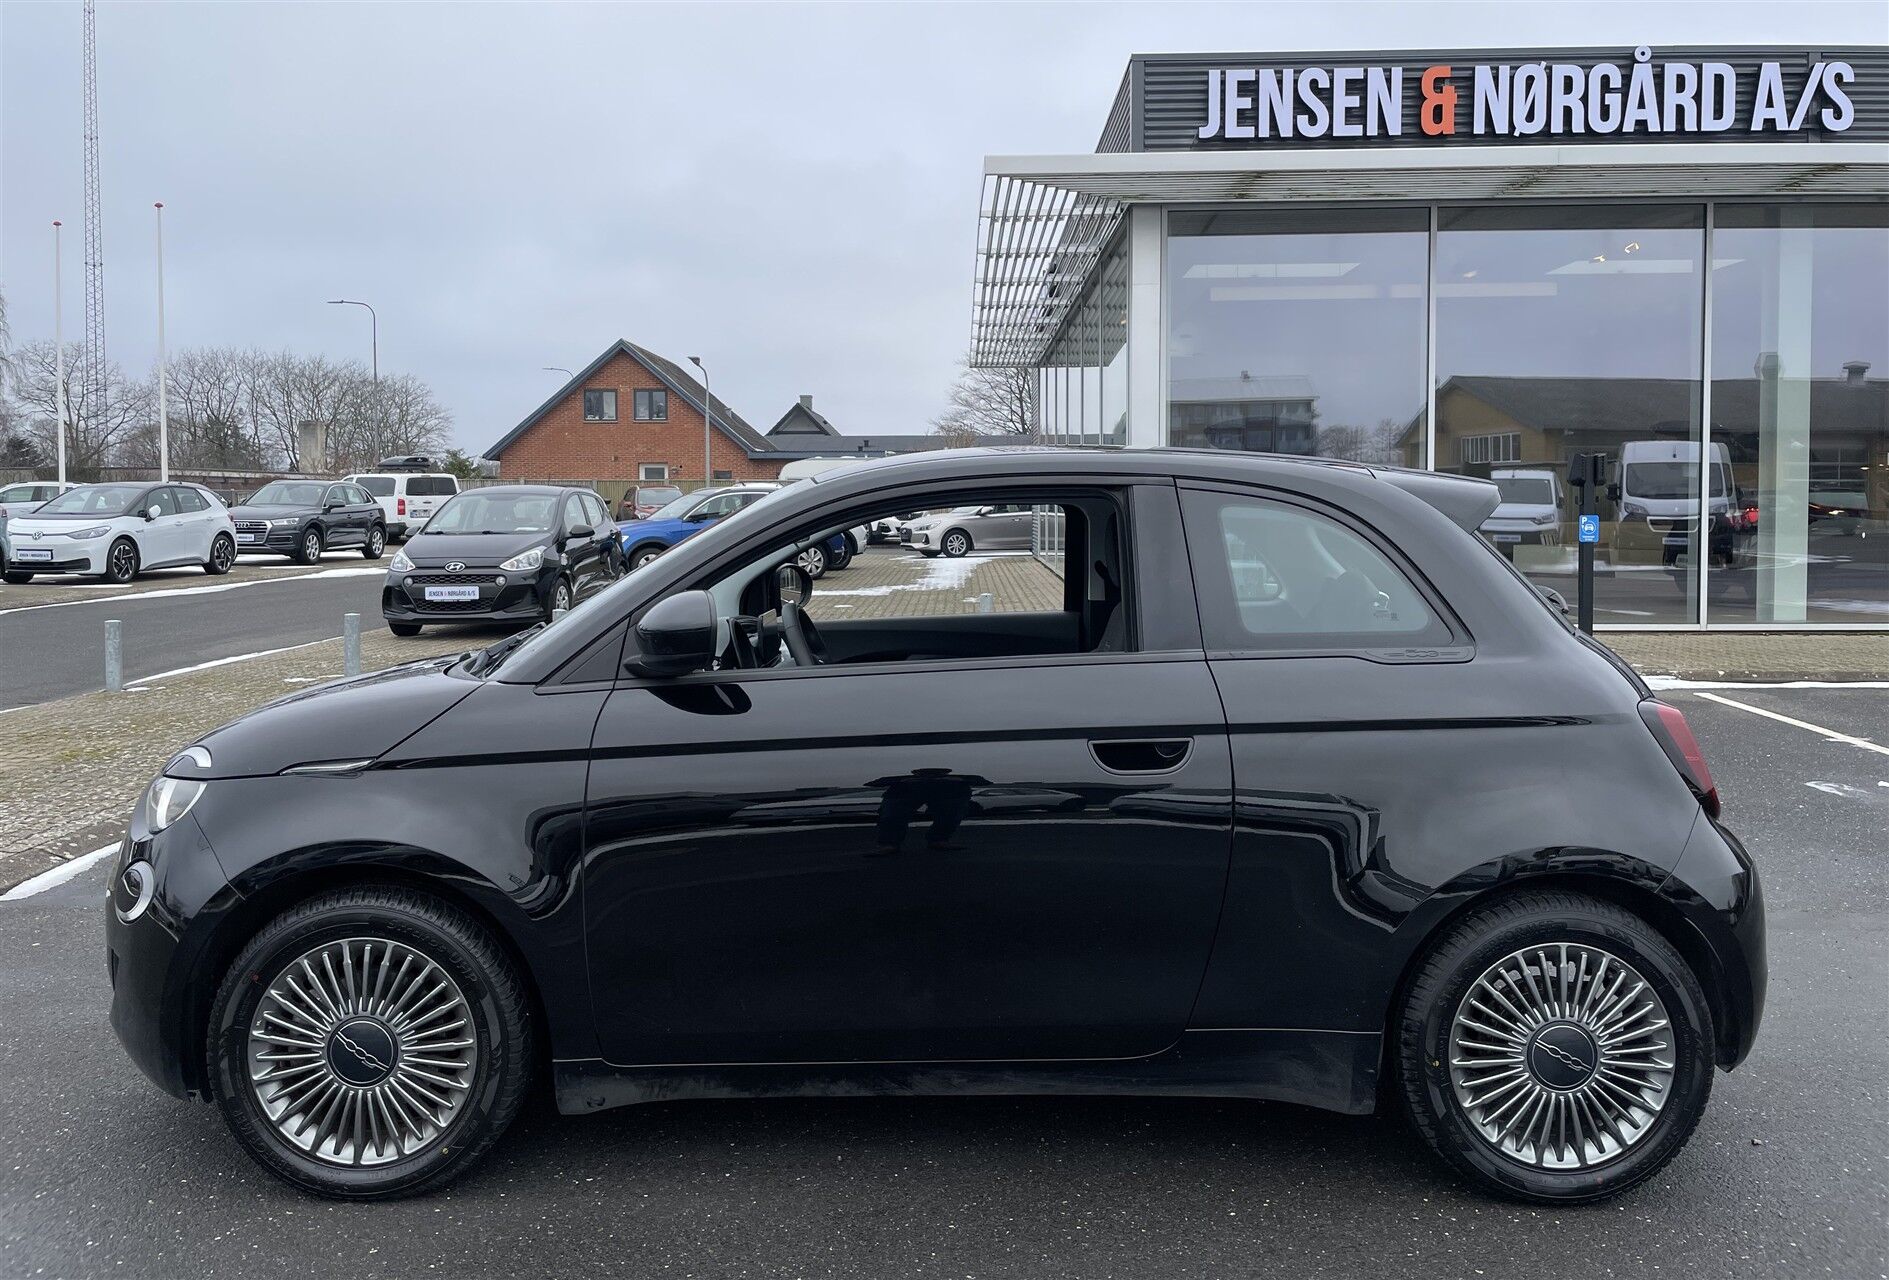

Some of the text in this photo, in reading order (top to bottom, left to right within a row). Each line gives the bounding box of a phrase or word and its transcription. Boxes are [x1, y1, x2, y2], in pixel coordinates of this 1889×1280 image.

[1199, 45, 1854, 138] JENSEN & NØRGÅRD A/S
[1581, 516, 1588, 524] P
